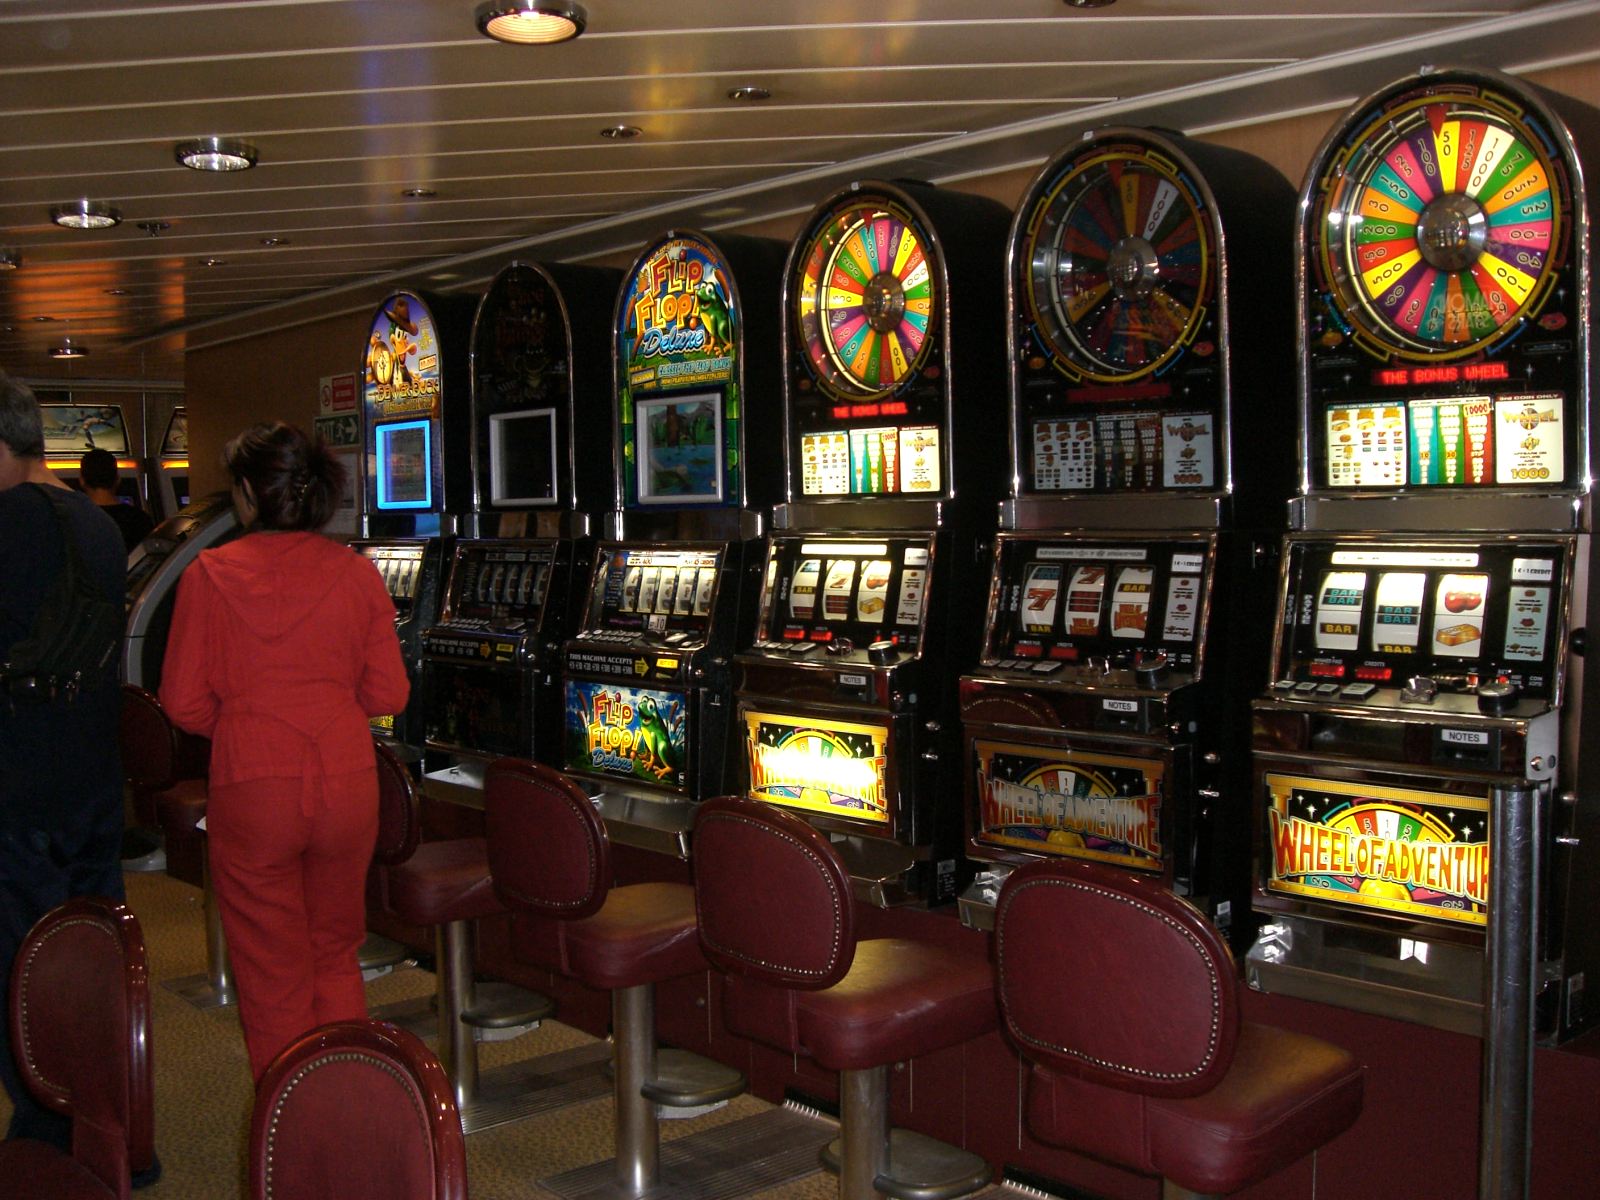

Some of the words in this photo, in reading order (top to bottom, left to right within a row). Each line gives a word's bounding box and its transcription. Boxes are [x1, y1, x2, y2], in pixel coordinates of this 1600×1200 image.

[1443, 131, 1451, 156] 50
[1462, 129, 1476, 170] 125
[1418, 138, 1436, 176] 100
[1472, 137, 1499, 187] 1000
[1502, 151, 1525, 176] 75
[1395, 154, 1413, 177] 25
[1379, 175, 1409, 200] 150
[1503, 175, 1538, 200] 250
[1148, 189, 1169, 232] 1000
[1368, 200, 1390, 213] 30
[1522, 201, 1547, 215] 25
[1363, 225, 1397, 236] 200
[1510, 229, 1548, 240] 100
[1363, 247, 1387, 260] 50
[1516, 252, 1542, 268] 40
[1372, 262, 1403, 285] 500
[1496, 267, 1527, 293] 100
[643, 327, 705, 359] Deluxe
[1381, 370, 1408, 384] THE
[1413, 367, 1459, 384] BONUS
[1464, 363, 1509, 380] WHEEL
[1511, 467, 1550, 480] 1000
[1123, 584, 1146, 592] BAR
[1384, 606, 1412, 614] BAR
[1383, 615, 1411, 624] BAR
[1030, 624, 1051, 633] BAR
[1325, 624, 1352, 634] BAR
[1384, 645, 1412, 653] BAR
[582, 654, 606, 662] MACHINE
[608, 656, 632, 665] ACCEPTS
[843, 676, 862, 684] NOTES
[1108, 702, 1132, 711] NOTES
[1449, 732, 1480, 742] NOTES
[1270, 808, 1356, 877] WHEEL
[1354, 837, 1385, 877] OF
